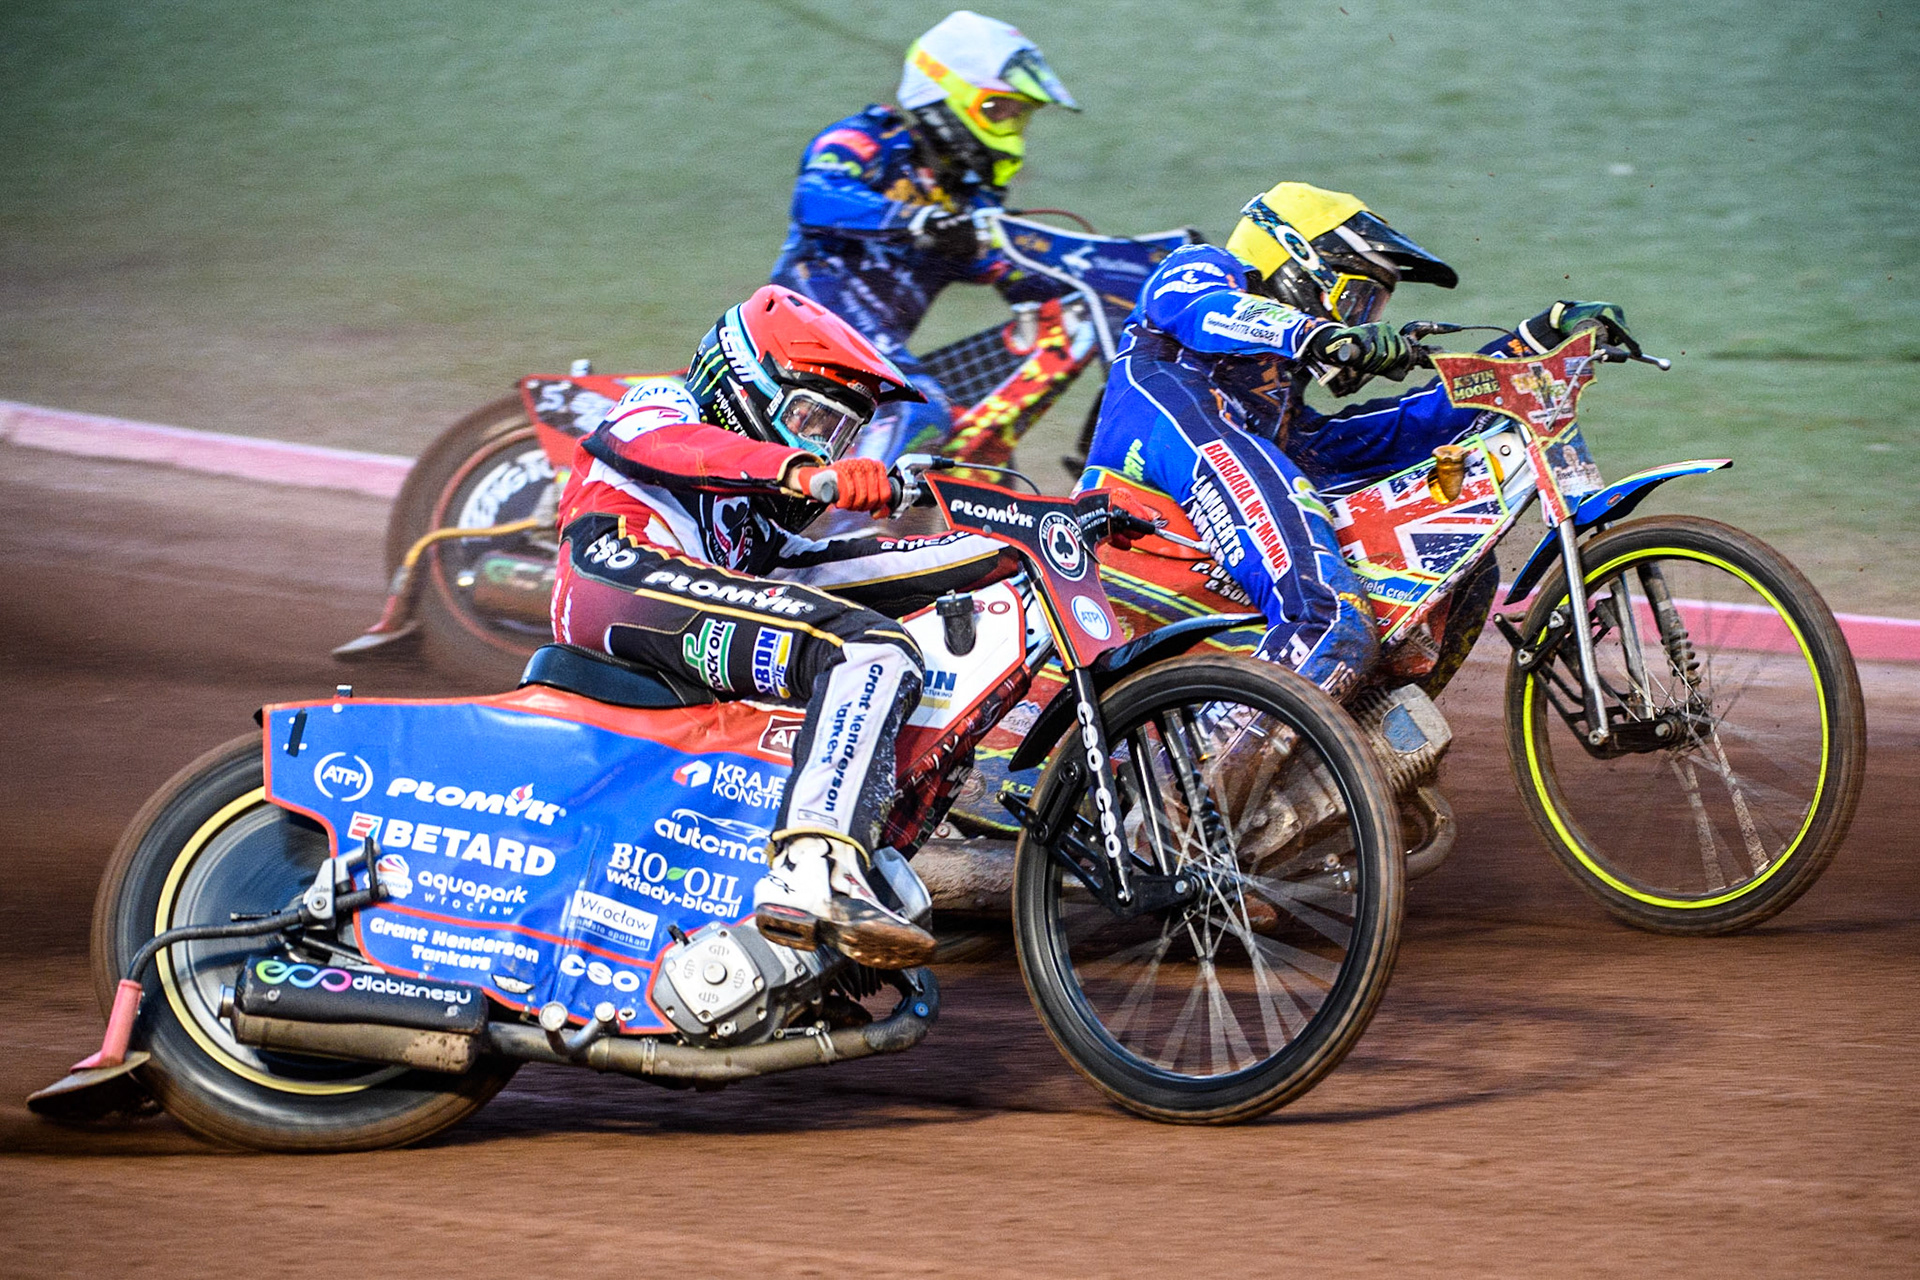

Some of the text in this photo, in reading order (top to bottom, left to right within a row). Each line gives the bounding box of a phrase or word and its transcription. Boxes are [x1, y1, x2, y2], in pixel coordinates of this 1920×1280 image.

[715, 388, 749, 438] MONSTE
[1204, 444, 1255, 504] BARBARA
[1190, 475, 1245, 568] LAMBERTS
[709, 621, 726, 649] OIL
[858, 663, 883, 711] Grant
[322, 765, 364, 789] ATPI
[716, 762, 787, 796] KRAJE
[383, 819, 556, 877] BETARD
[654, 818, 767, 864] automa
[418, 871, 528, 903] aquapark
[370, 917, 539, 963] Grant Henderson
[411, 944, 491, 970] Tankers
